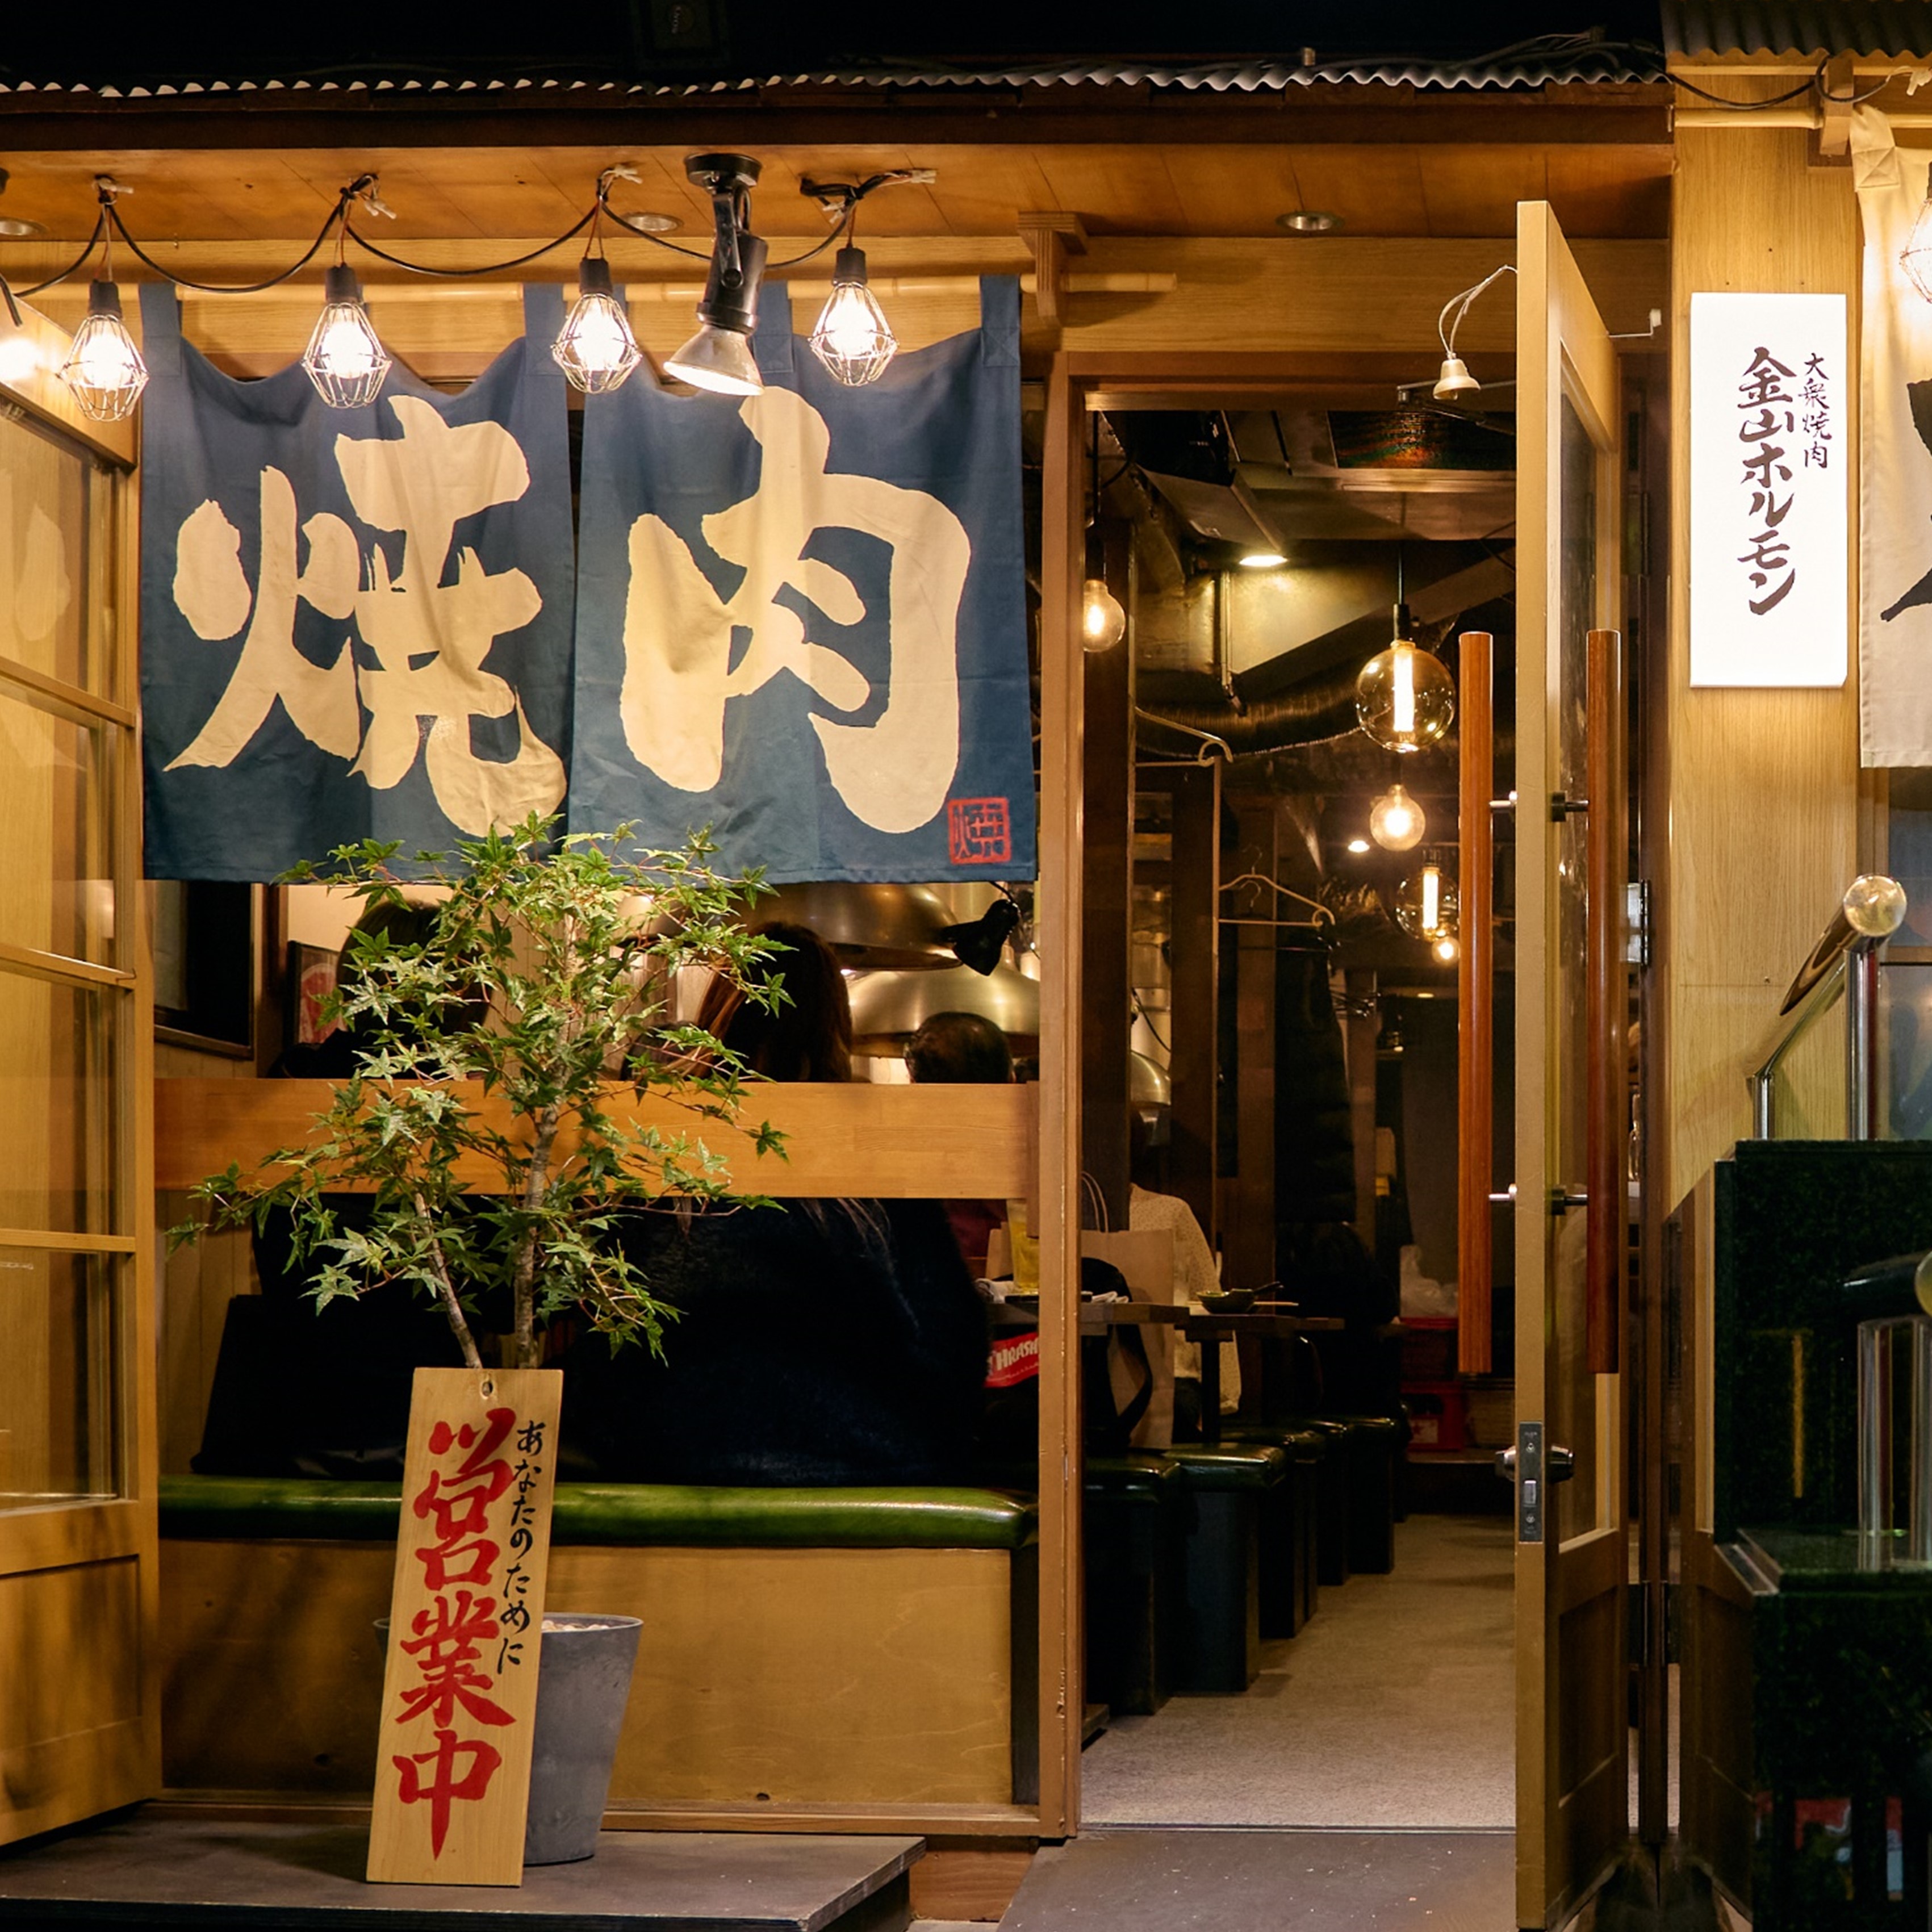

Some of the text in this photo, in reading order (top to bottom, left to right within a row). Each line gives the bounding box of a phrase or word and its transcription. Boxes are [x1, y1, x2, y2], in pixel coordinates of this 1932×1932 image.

[1737, 346, 1797, 616] 金山ホルモン
[1798, 352, 1833, 469] 大衆焼肉
[164, 386, 971, 837] 焼肉
[392, 1408, 517, 1860] 営業中
[497, 1420, 545, 1674] あなたのために
